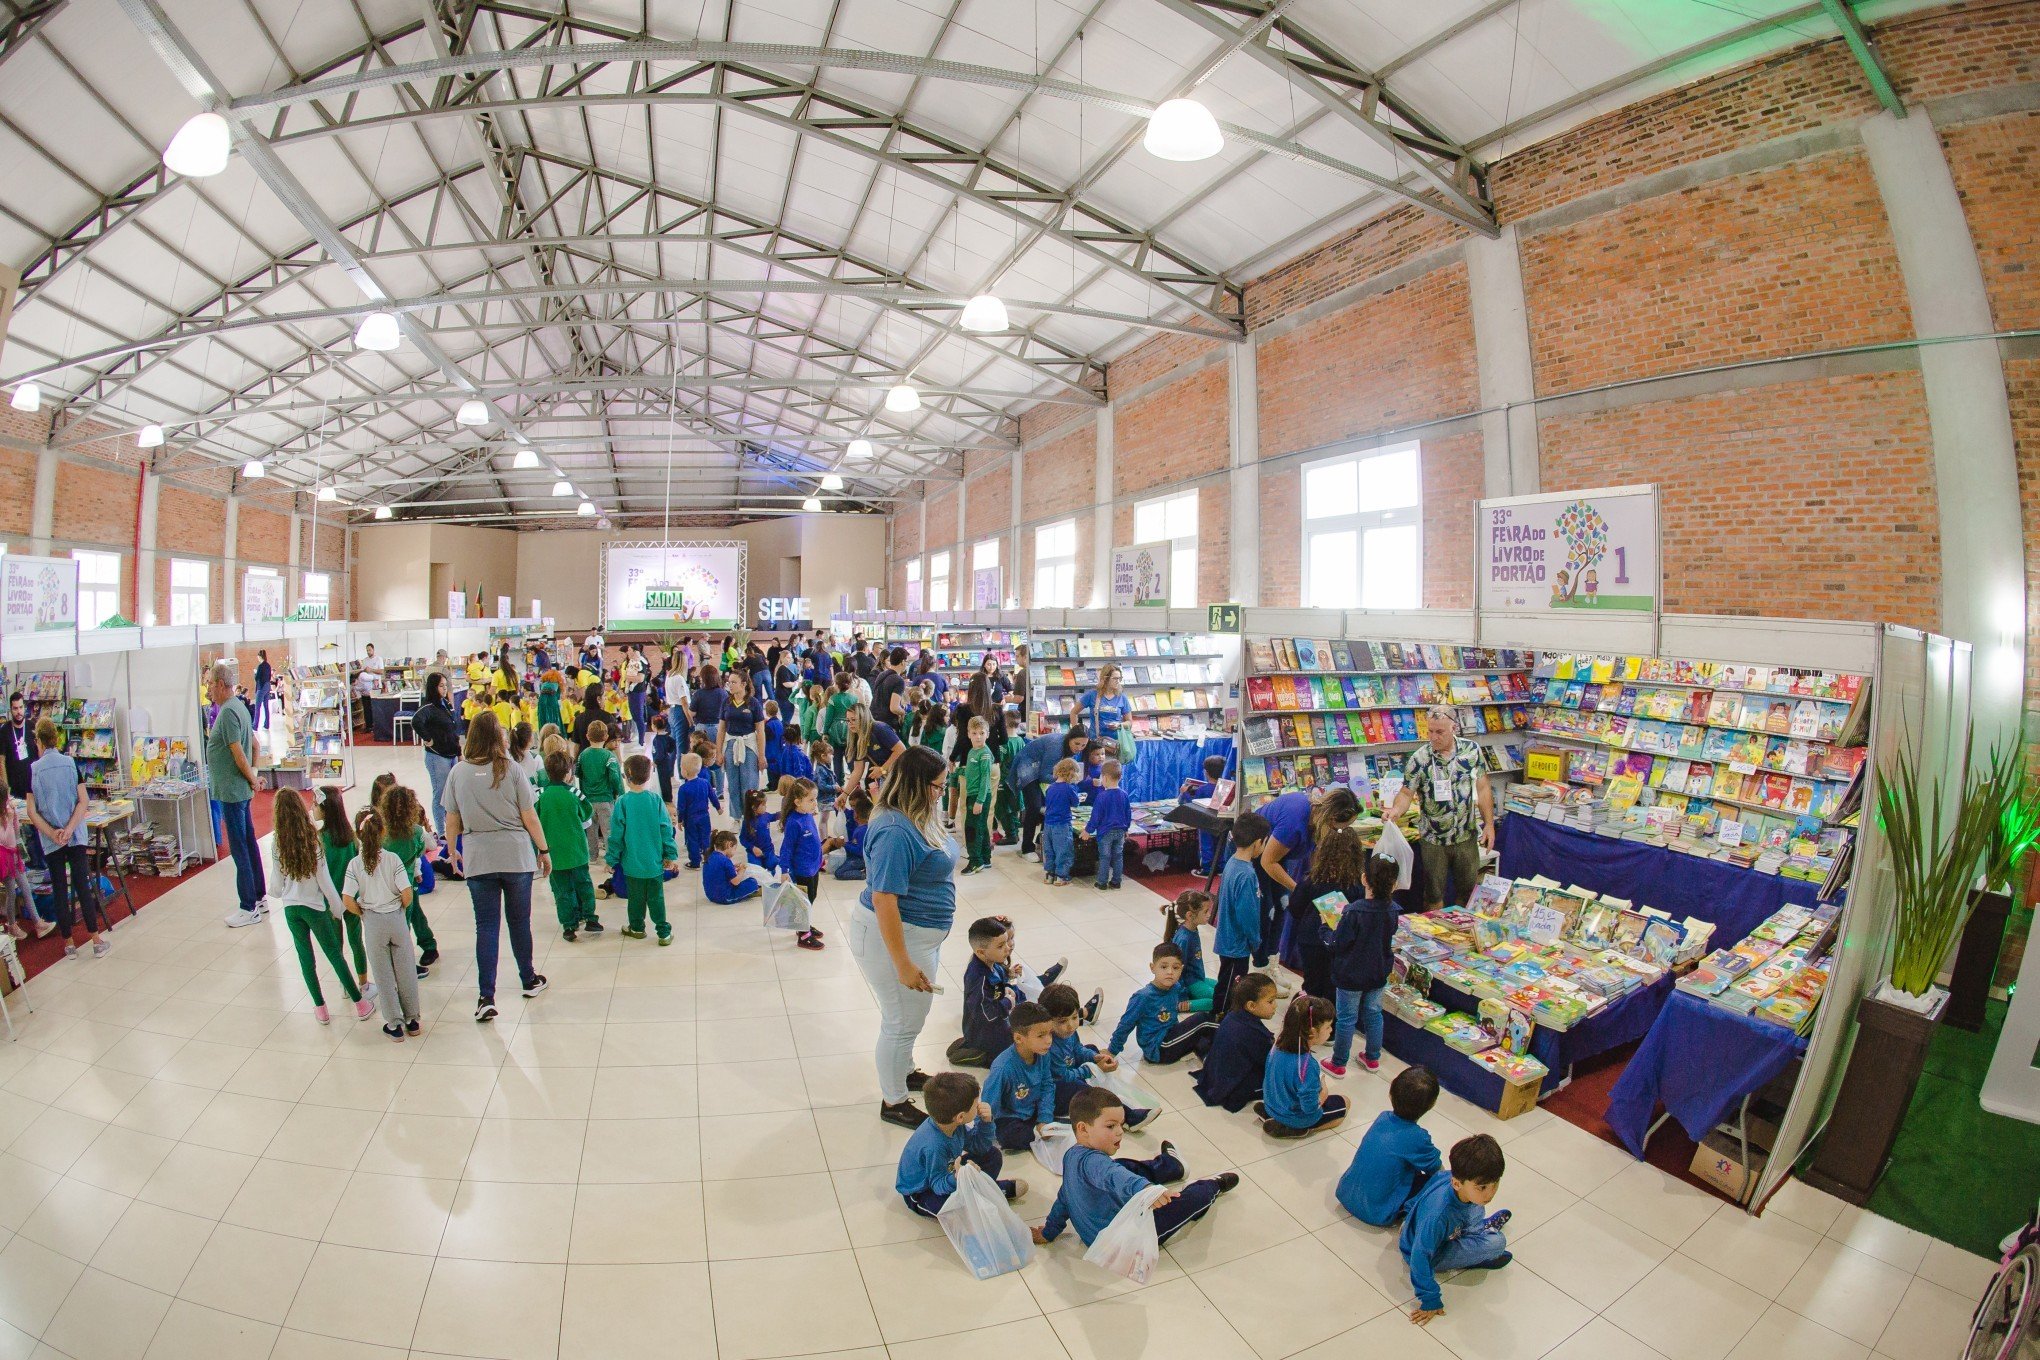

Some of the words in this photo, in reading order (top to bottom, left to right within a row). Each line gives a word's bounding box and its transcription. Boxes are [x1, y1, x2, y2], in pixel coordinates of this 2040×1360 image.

[1492, 525, 1531, 545] FEIRA
[1532, 528, 1546, 541] DO
[1492, 545, 1532, 563] LIVRO
[1533, 549, 1545, 562] DE
[1614, 546, 1630, 584] 1
[1154, 573, 1161, 594] 2
[1491, 562, 1546, 584] PORTÃO
[61, 593, 68, 616] 8
[758, 597, 811, 621] SEME
